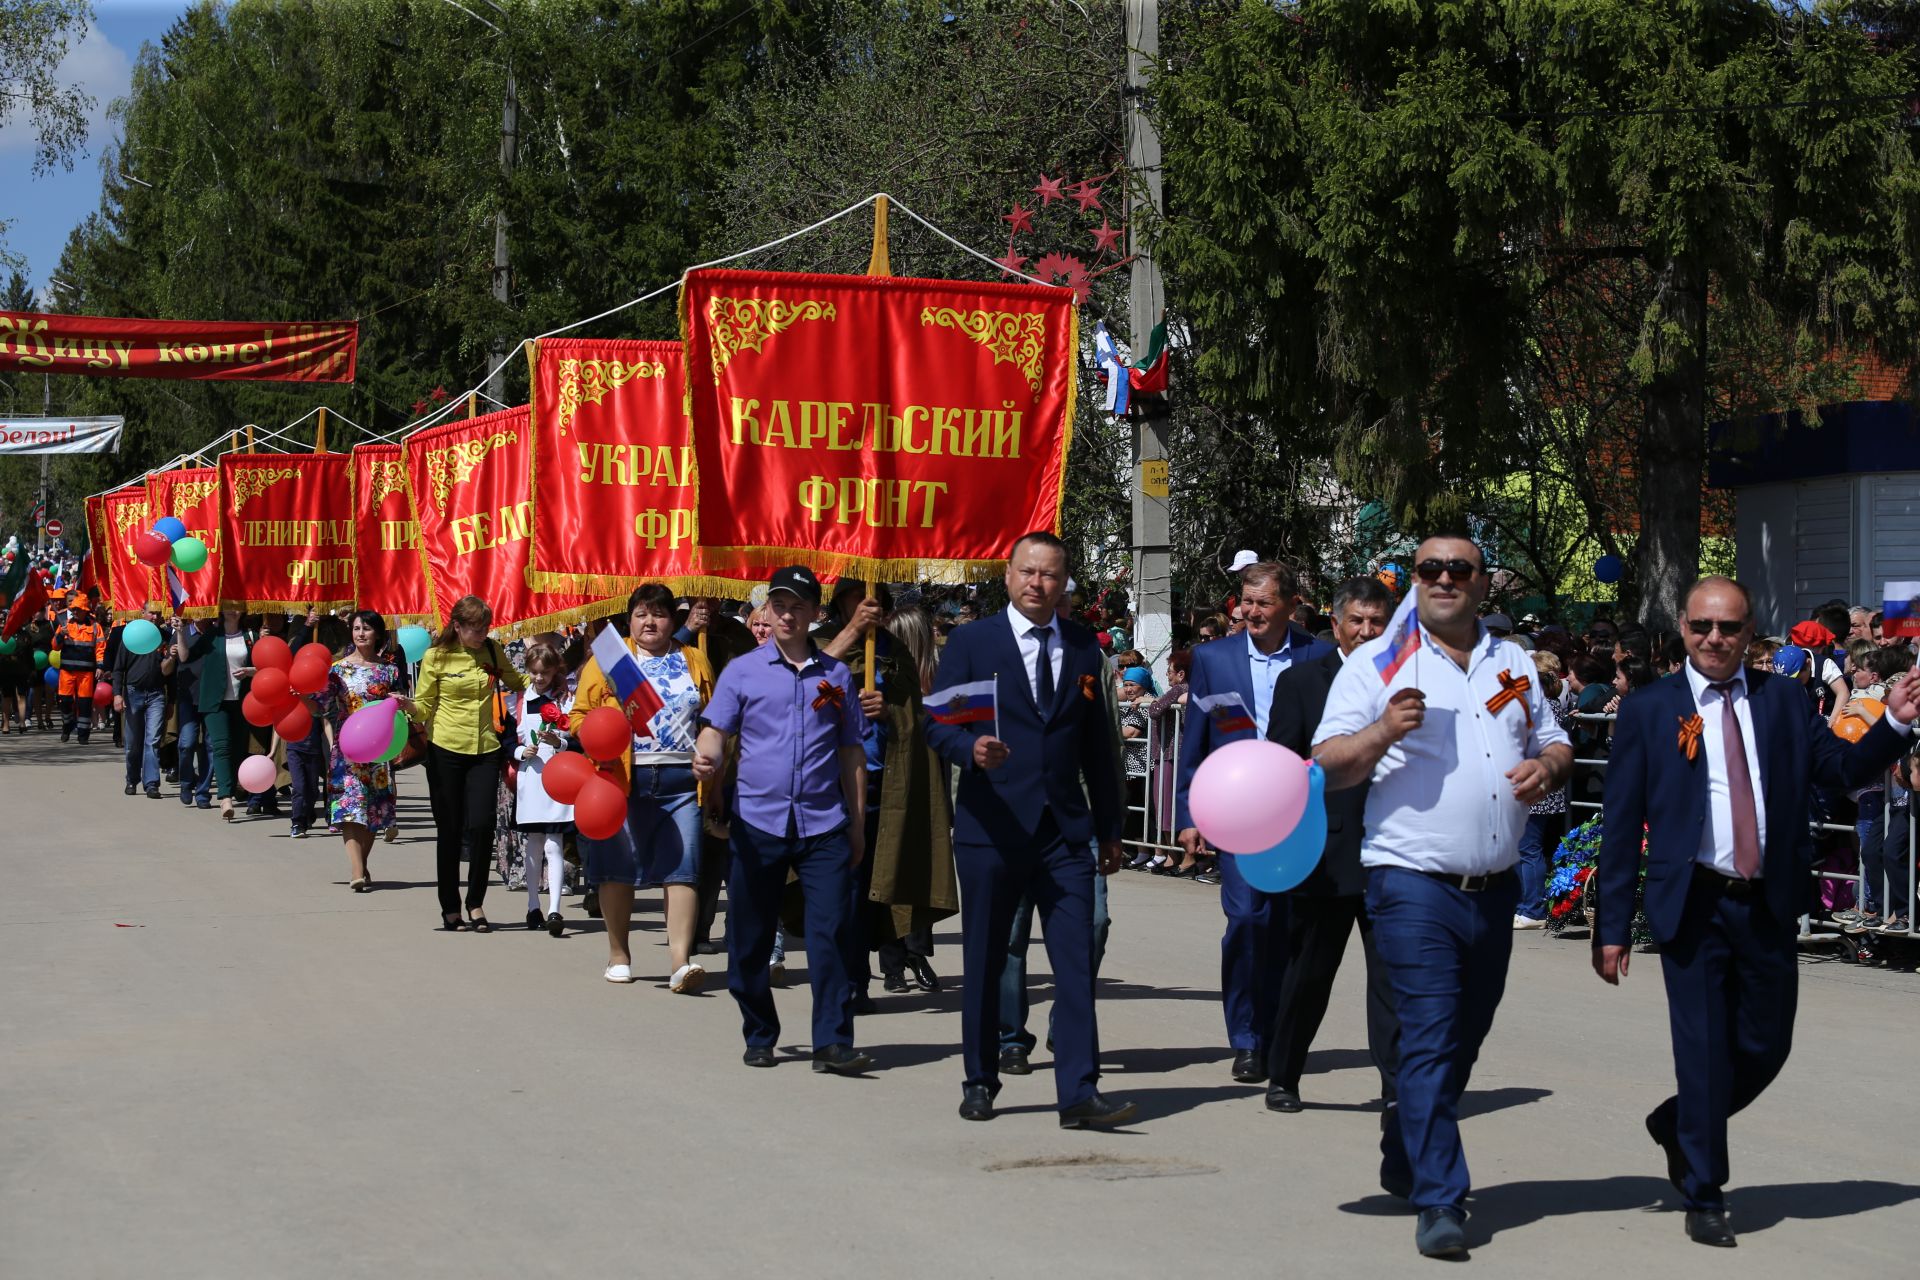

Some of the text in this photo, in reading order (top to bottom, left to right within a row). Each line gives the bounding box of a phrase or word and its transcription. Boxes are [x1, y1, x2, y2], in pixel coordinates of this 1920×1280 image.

[729, 397, 1024, 458] КАРЕЛЬСКИЙ
[798, 475, 949, 528] ФРОНТ
[635, 508, 698, 550] ФР
[286, 558, 354, 586] ФРОНТ
